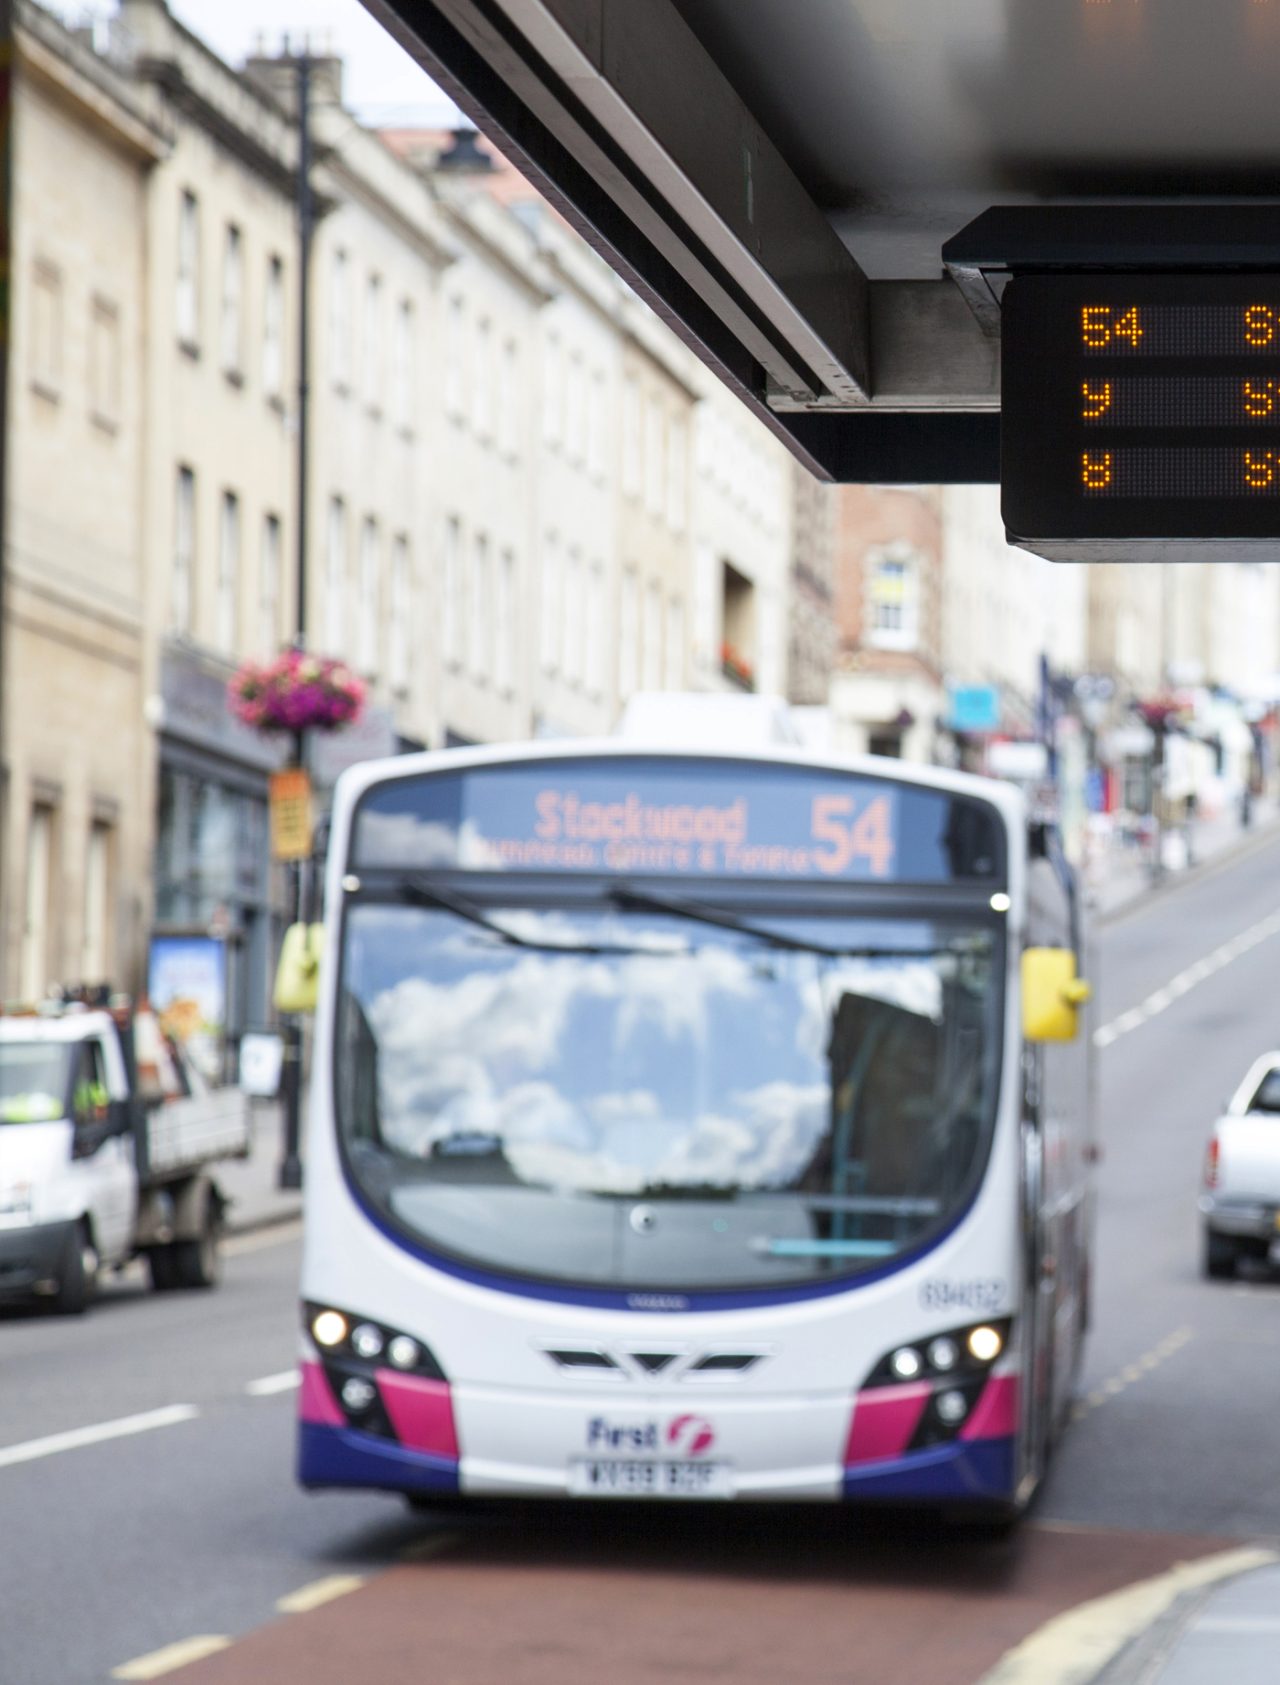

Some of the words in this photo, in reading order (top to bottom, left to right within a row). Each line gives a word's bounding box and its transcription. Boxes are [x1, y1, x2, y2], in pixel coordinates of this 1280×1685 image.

[1082, 306, 1143, 347] 54
[535, 790, 747, 842] Stockwood
[811, 794, 892, 875] 54
[587, 1416, 658, 1449] First
